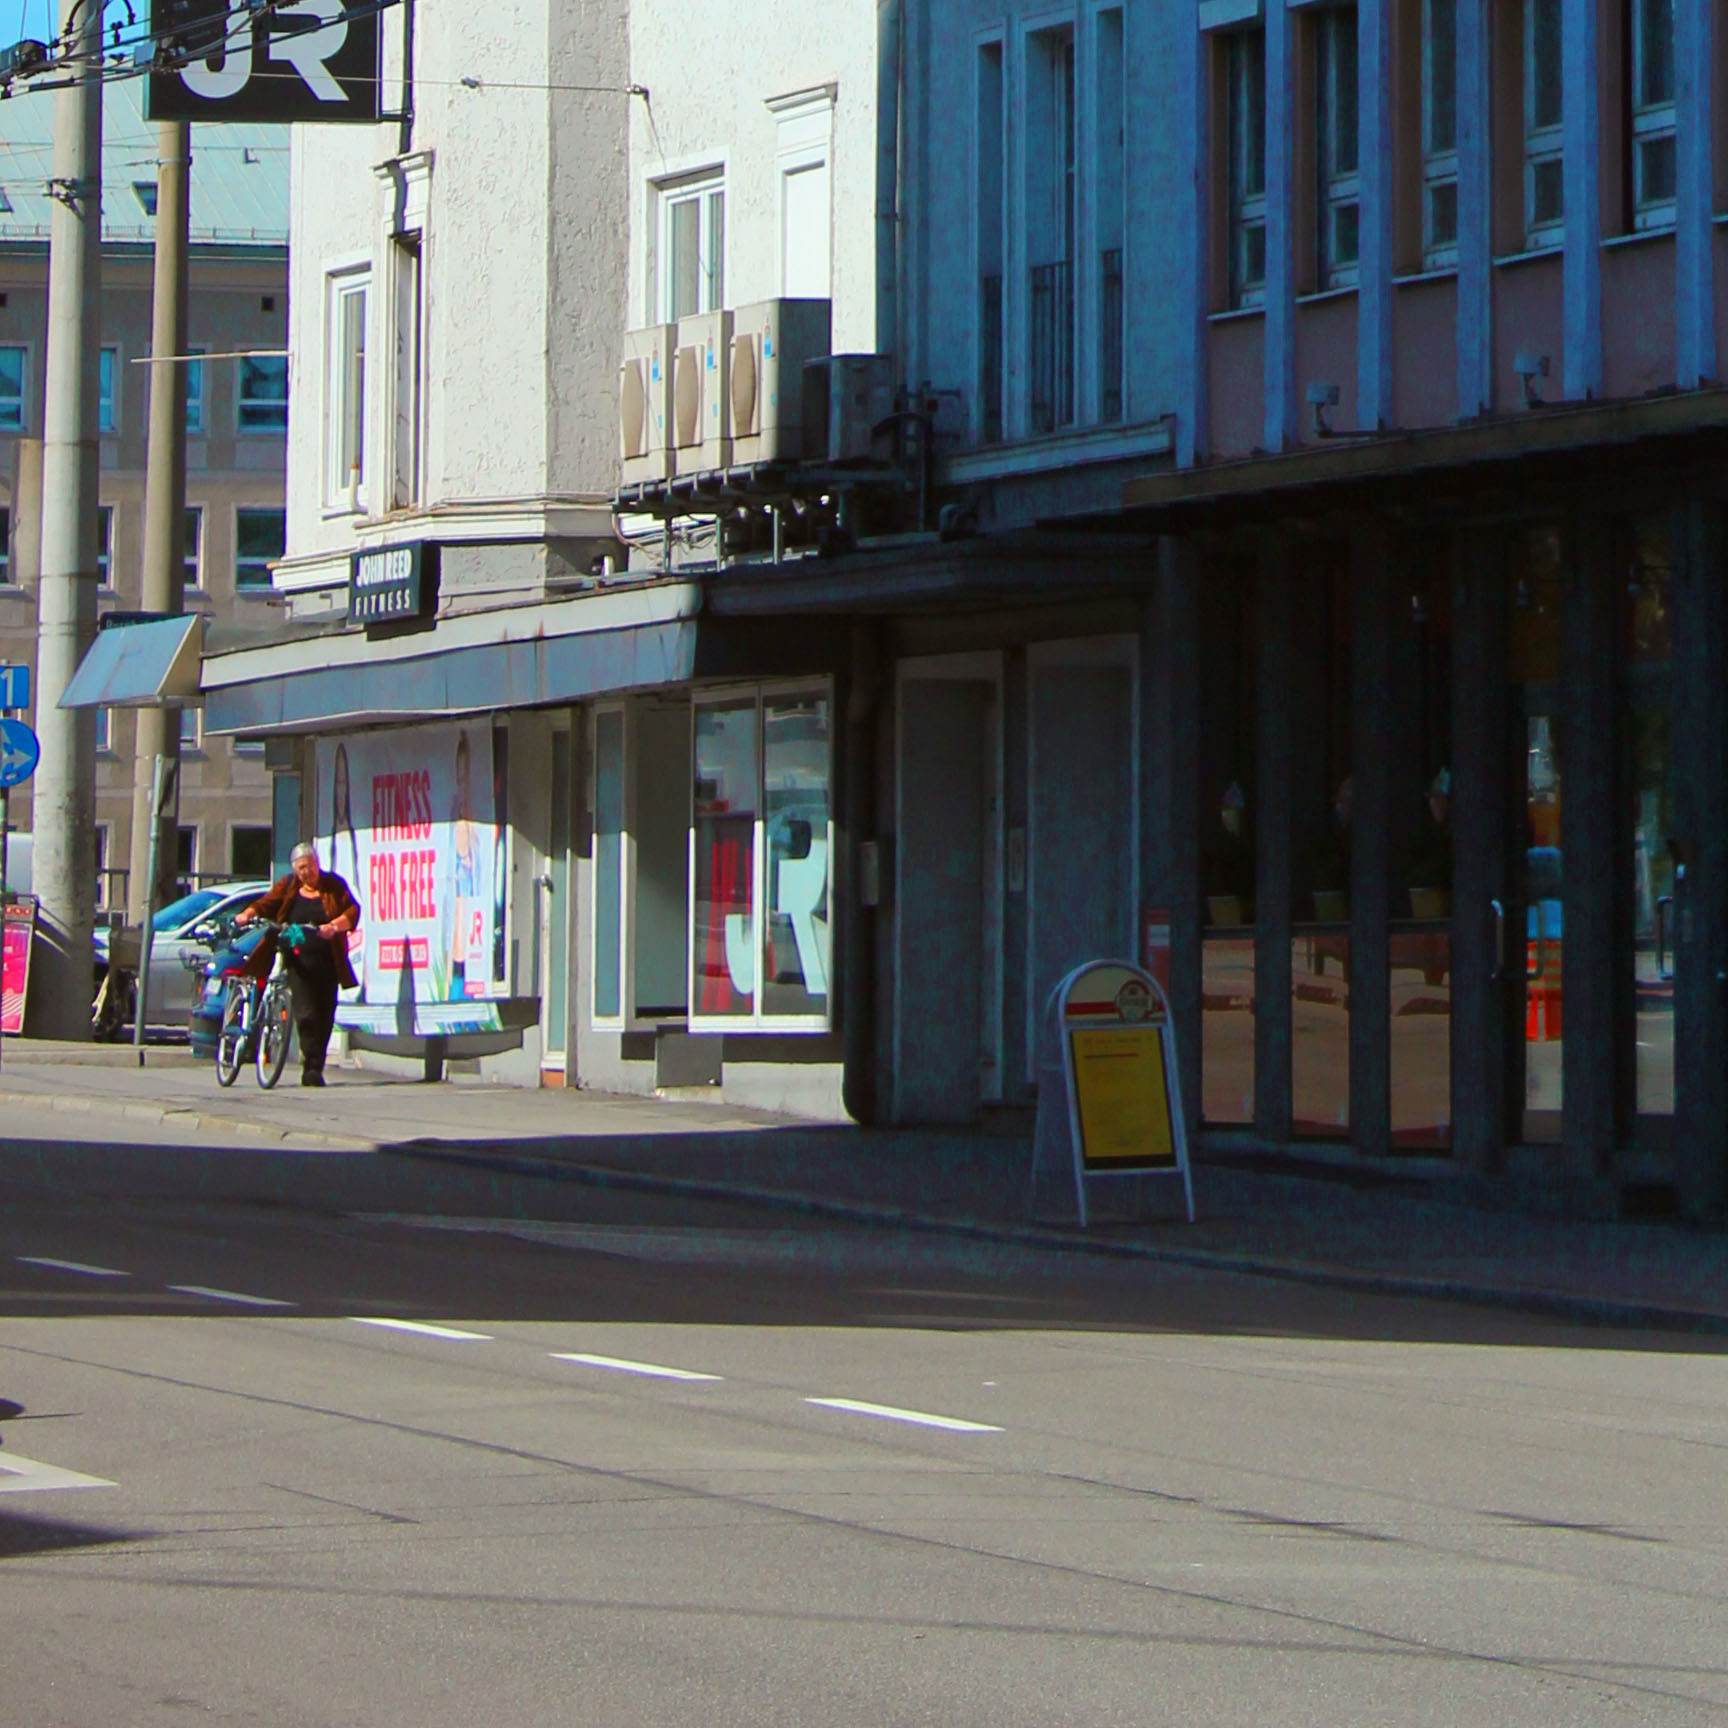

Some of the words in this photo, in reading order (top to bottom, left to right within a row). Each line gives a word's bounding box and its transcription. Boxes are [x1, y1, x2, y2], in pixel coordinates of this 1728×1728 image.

[355, 588, 411, 617] FITNESS
[371, 770, 432, 842] FITNESS
[370, 853, 398, 922] FOR
[400, 849, 436, 921] FREE
